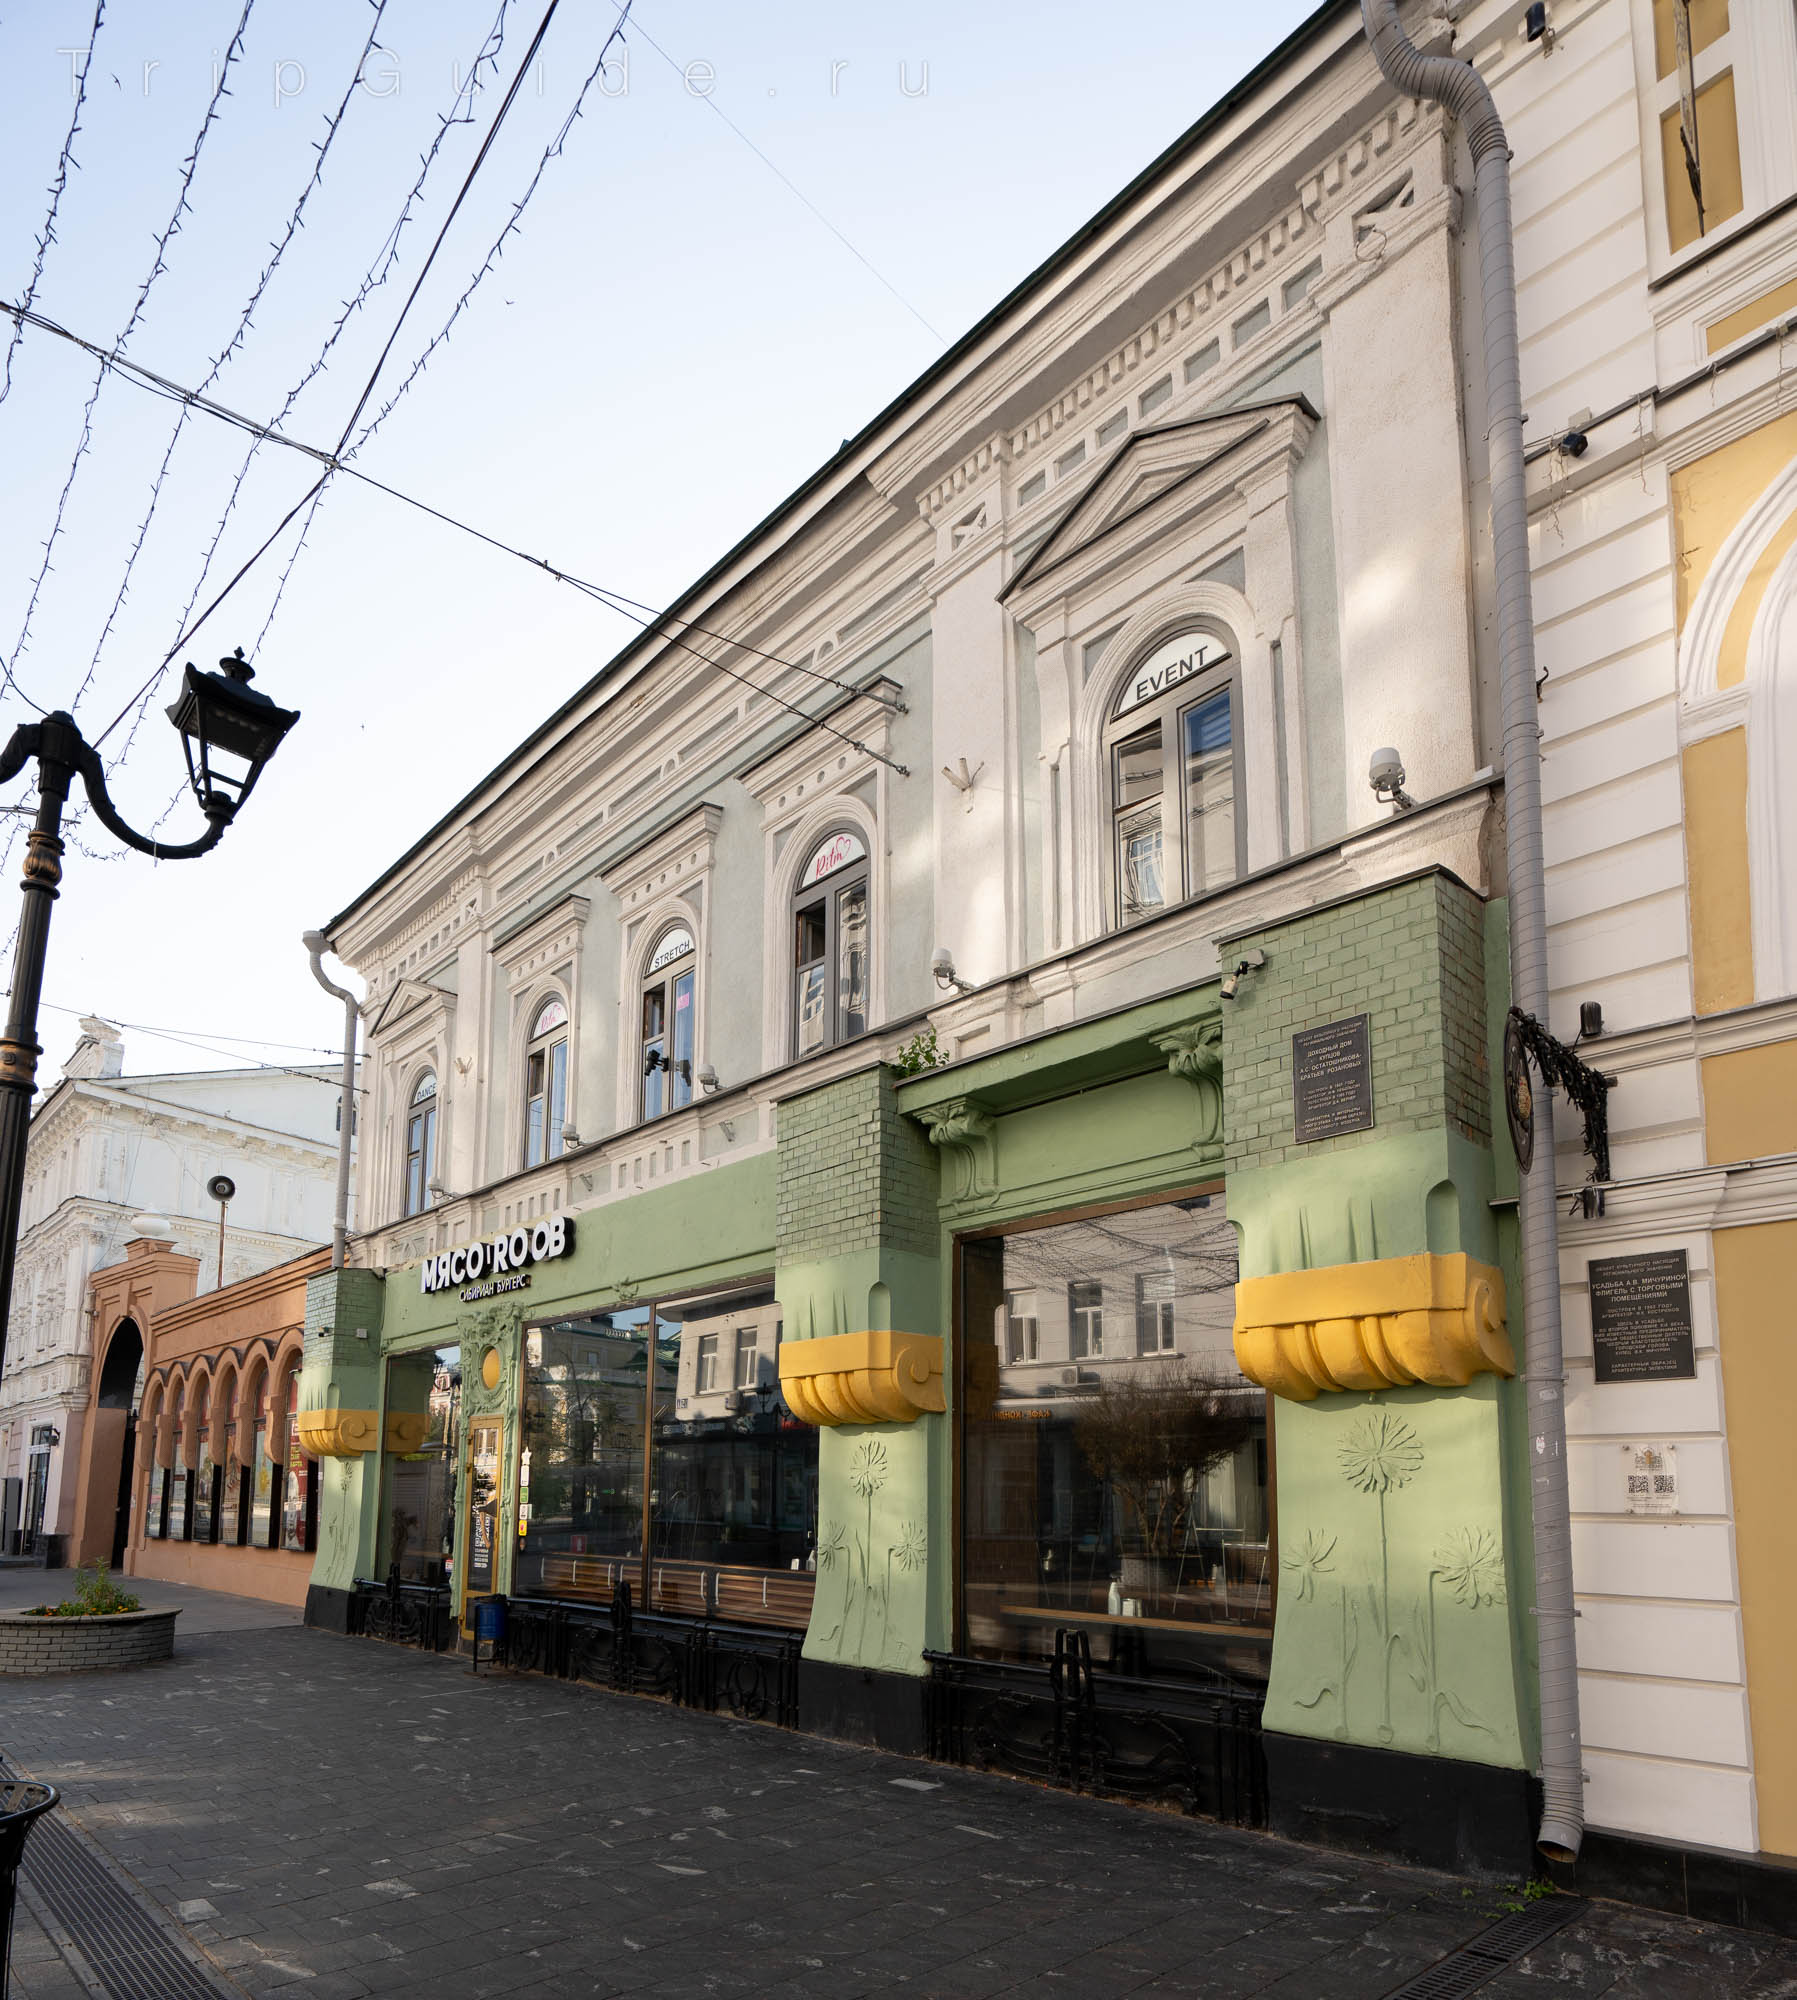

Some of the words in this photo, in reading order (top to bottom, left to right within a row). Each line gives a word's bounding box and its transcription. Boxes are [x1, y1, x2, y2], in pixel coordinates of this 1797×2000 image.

[1137, 645, 1208, 701] EVENT
[654, 939, 690, 968] STRETCH
[1340, 1040, 1352, 1049] ДОМ
[459, 1284, 494, 1302] СИБИРИАН
[496, 1274, 526, 1292] БУРГЕРС
[1592, 1281, 1623, 1290] УСАДЬБА
[1642, 1274, 1686, 1284] МИЧУРИНОЙ
[1595, 1288, 1628, 1297] ФЛИГЕЛЬ
[1638, 1282, 1683, 1292] ТОРГОВЫМИ
[1611, 1292, 1668, 1302] ПОМЕЩЕНИЯМИ
